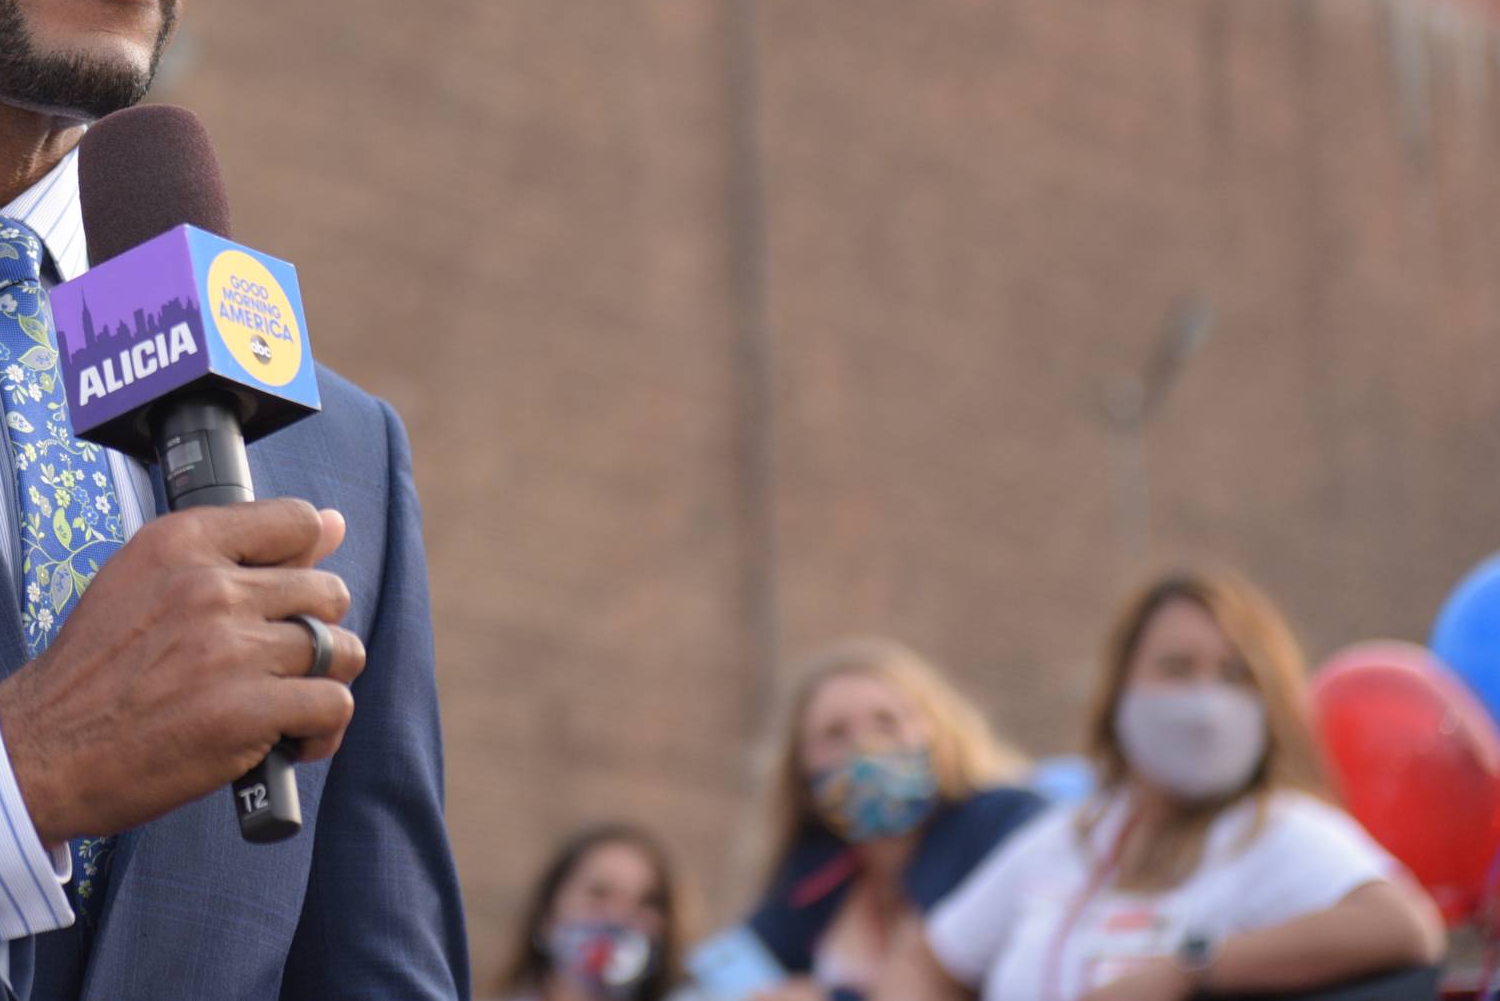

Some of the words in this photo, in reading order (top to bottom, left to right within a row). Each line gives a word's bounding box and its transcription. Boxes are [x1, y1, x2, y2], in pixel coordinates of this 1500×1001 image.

[222, 286, 281, 319] MORNING
[230, 274, 269, 300] GOOD
[219, 301, 294, 344] AMERICA
[79, 321, 198, 407] ALICIA
[251, 338, 272, 359] abc
[239, 783, 268, 812] T2
